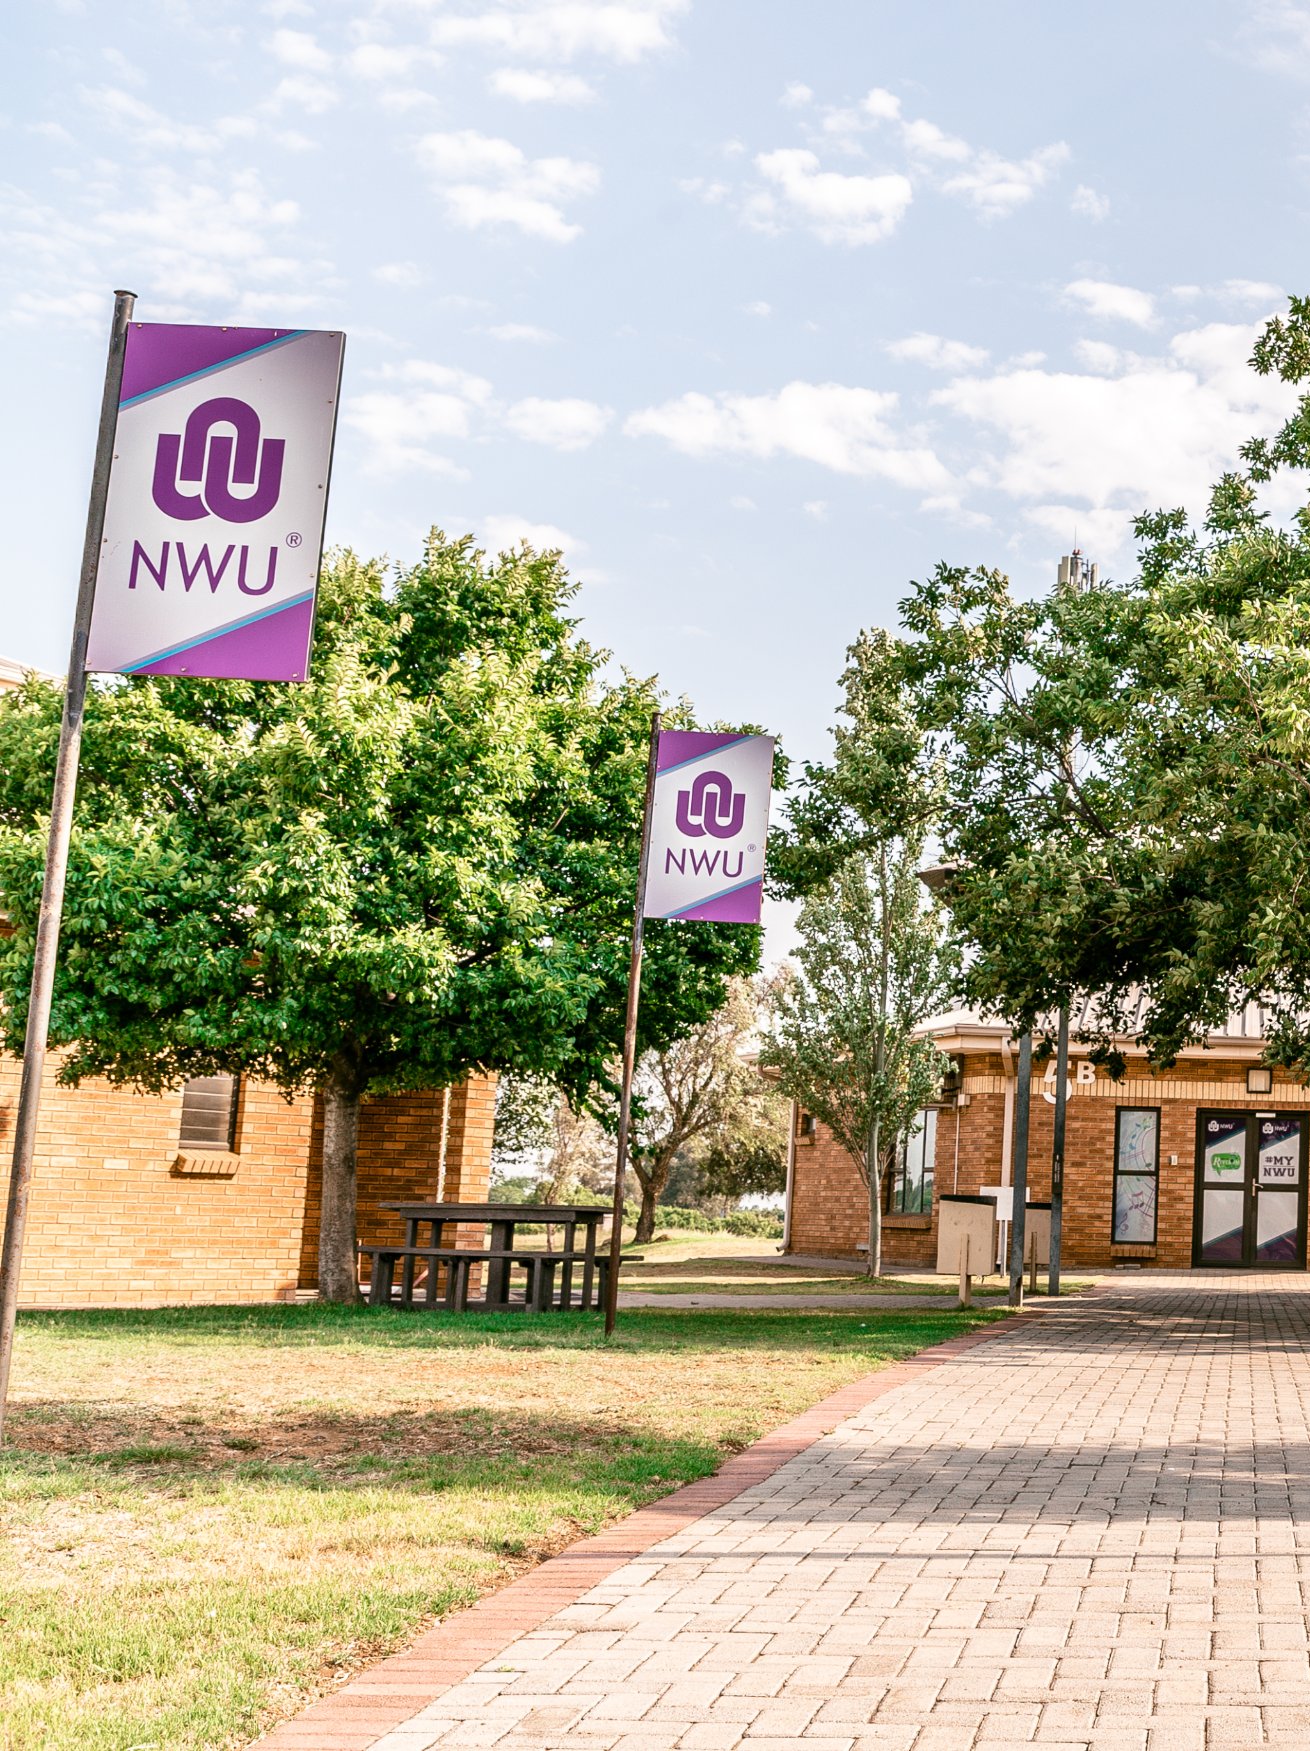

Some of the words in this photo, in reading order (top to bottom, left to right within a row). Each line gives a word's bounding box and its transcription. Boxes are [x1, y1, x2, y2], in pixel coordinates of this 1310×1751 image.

[128, 539, 278, 596] NWU
[665, 847, 744, 878] NWU
[1265, 1156, 1294, 1166] #MY
[1263, 1168, 1296, 1177] NWU
